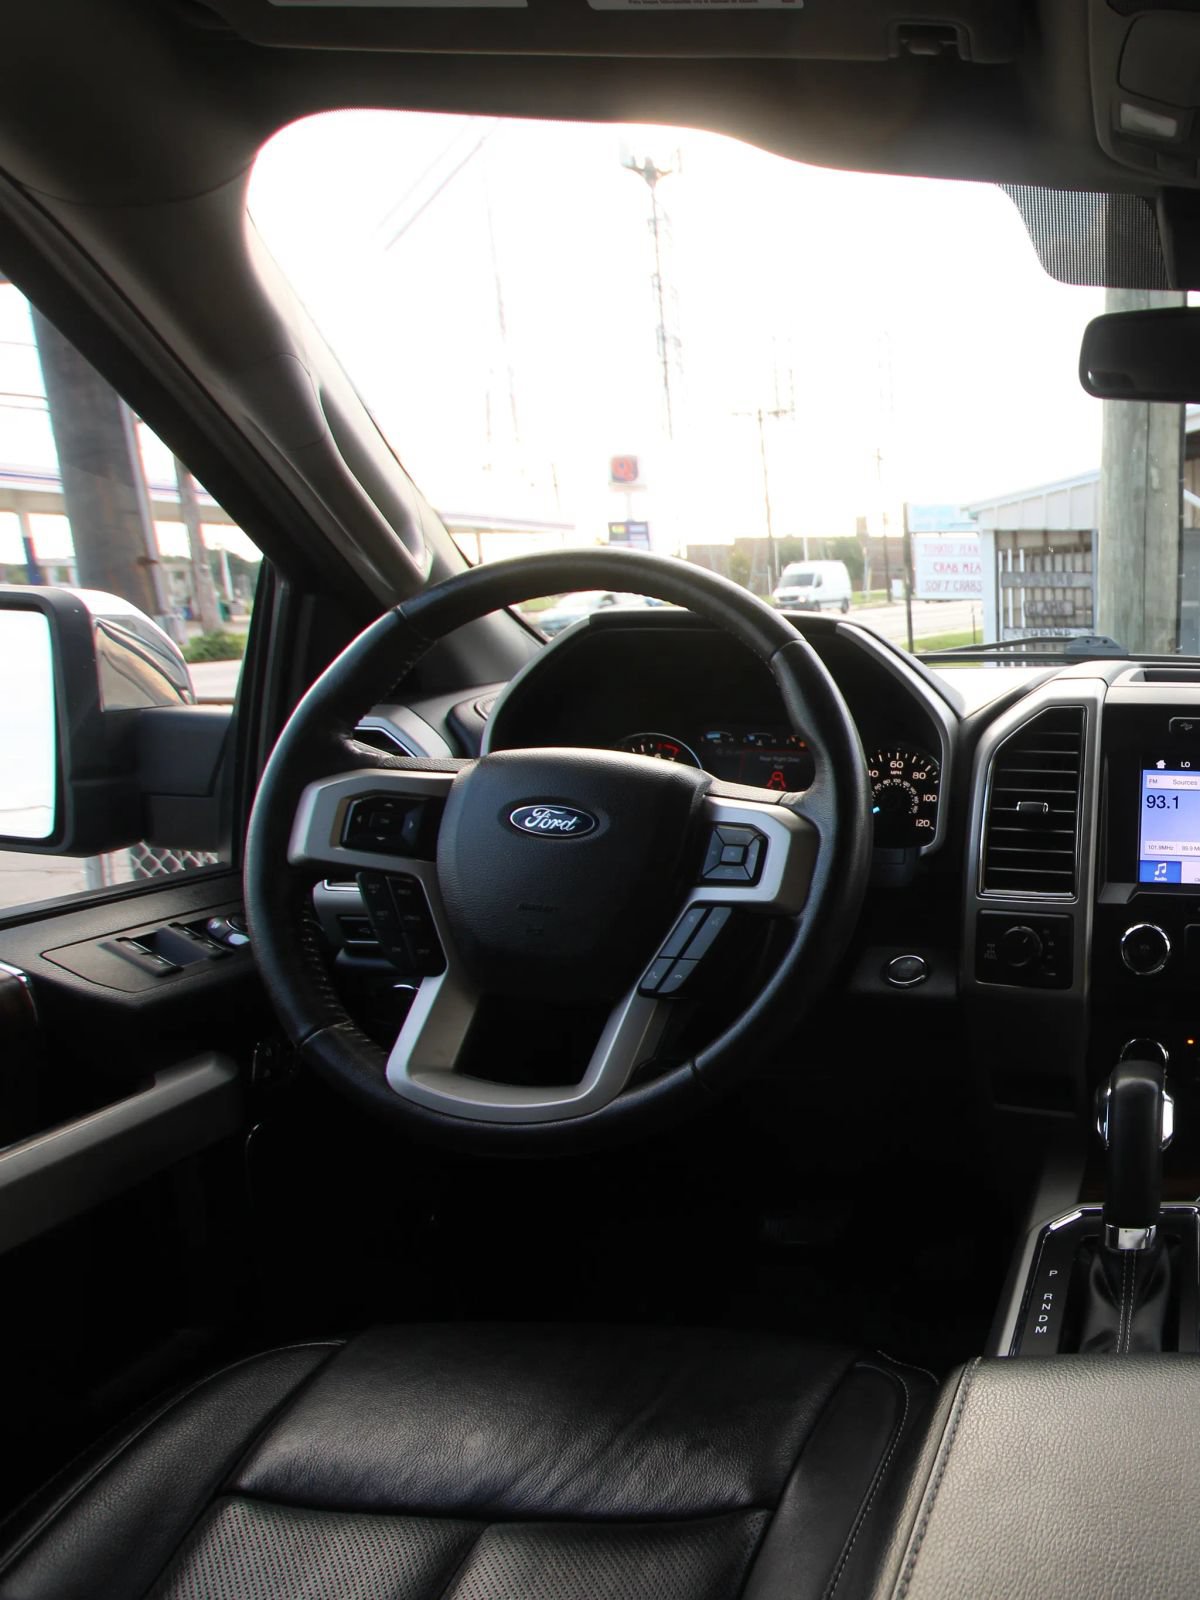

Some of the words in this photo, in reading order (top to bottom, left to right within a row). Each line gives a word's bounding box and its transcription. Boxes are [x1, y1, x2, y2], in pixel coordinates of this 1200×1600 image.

[962, 561, 982, 575] MEA
[890, 760, 904, 768] 60
[912, 771, 927, 779] 80
[1172, 778, 1198, 786] Sources
[923, 794, 937, 802] 100
[1145, 794, 1180, 810] 93.1
[524, 807, 579, 831] Ford
[915, 819, 930, 827] 120
[1049, 1269, 1058, 1277] P
[1043, 1292, 1053, 1300] R
[1041, 1303, 1051, 1311] N
[1038, 1314, 1048, 1322] D
[1034, 1325, 1047, 1334] M
